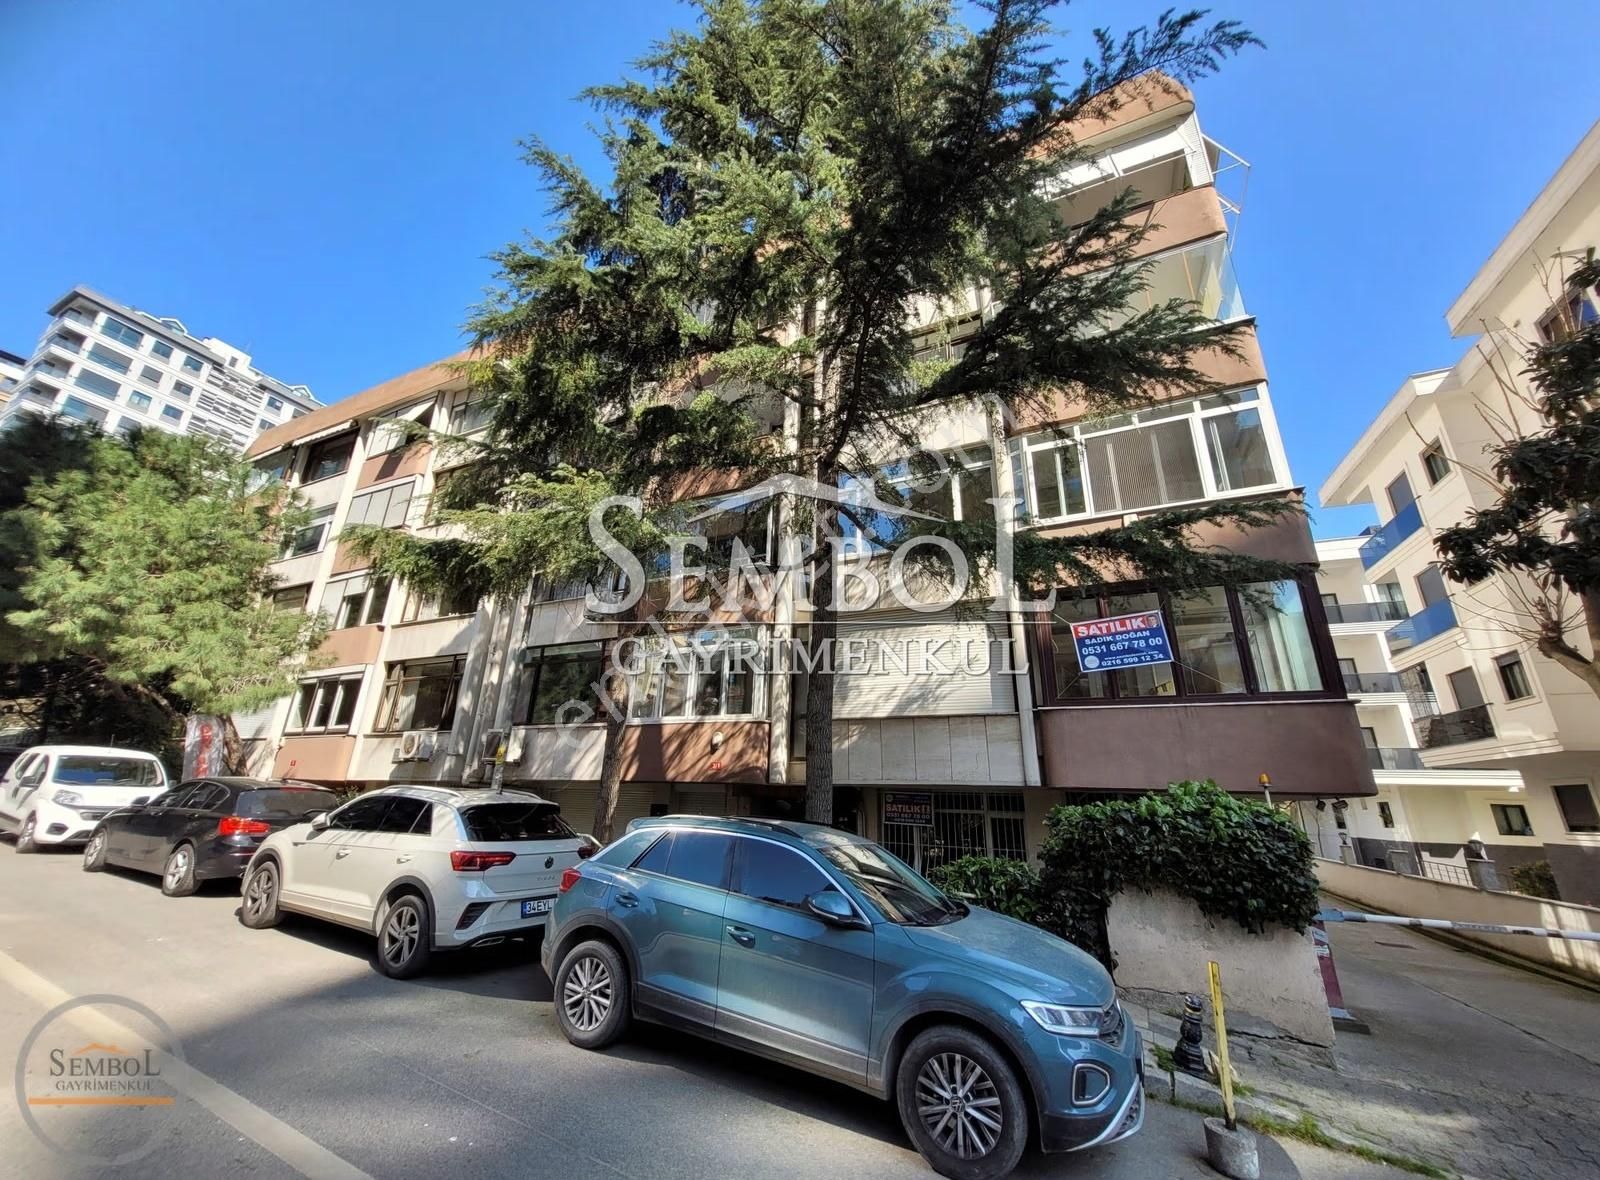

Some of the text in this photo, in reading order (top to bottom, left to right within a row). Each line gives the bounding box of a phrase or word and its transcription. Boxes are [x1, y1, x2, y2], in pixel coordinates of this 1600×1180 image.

[1078, 617, 1146, 637] SATILIK
[1085, 630, 1150, 645] SADIK DOĞAN
[1082, 637, 1163, 655] 0531 667 78 00
[1101, 658, 1122, 667] 0216
[1124, 656, 1139, 665] 599
[1141, 654, 1151, 662] 12
[886, 803, 921, 813] SATILIK
